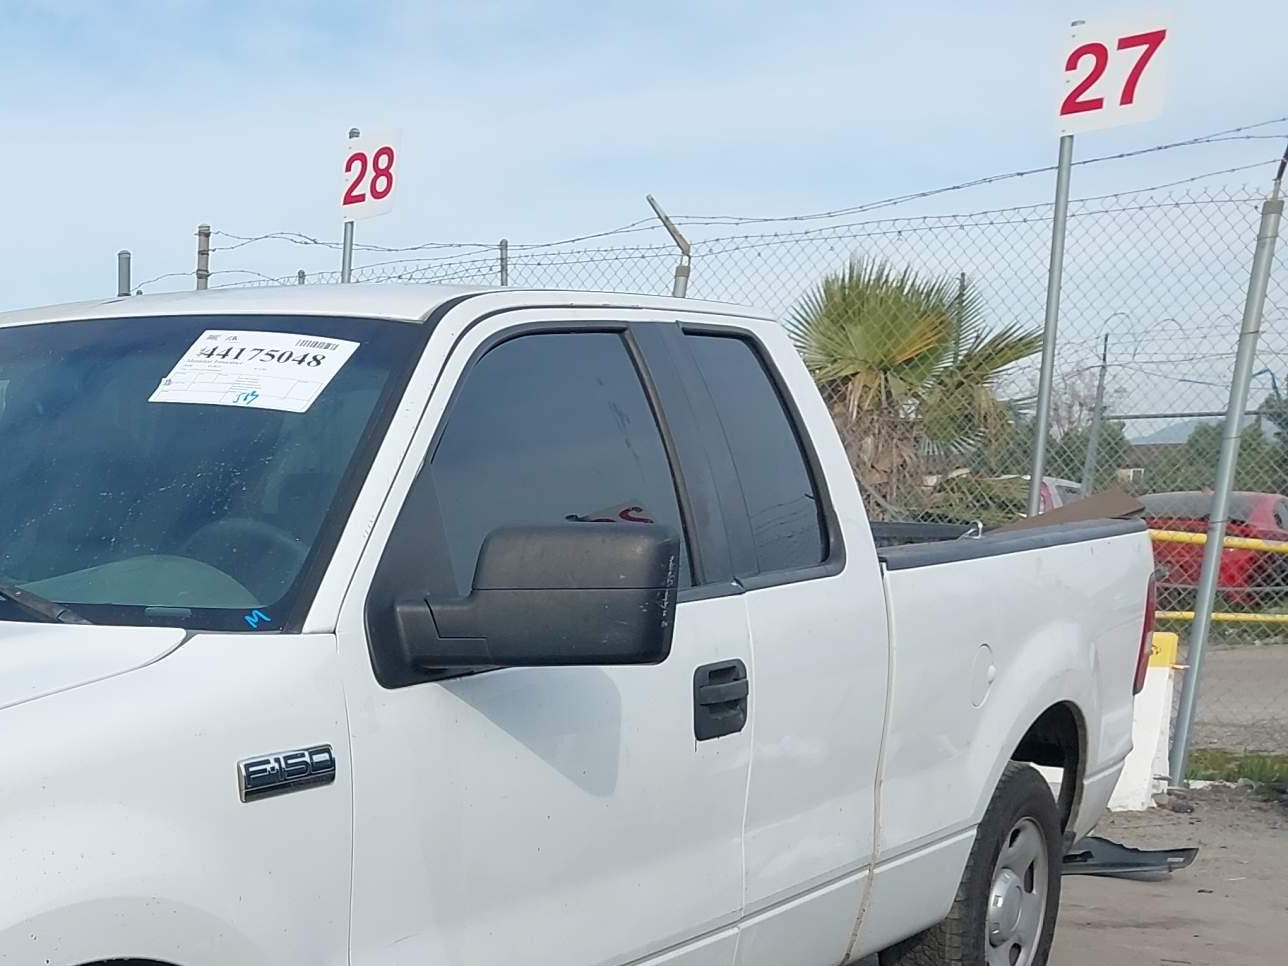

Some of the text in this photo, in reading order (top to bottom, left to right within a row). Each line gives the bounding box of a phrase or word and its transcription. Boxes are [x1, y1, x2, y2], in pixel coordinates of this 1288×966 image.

[1059, 29, 1167, 116] 27
[343, 146, 394, 206] 28
[201, 345, 327, 368] 44175048
[243, 747, 334, 788] F-150
